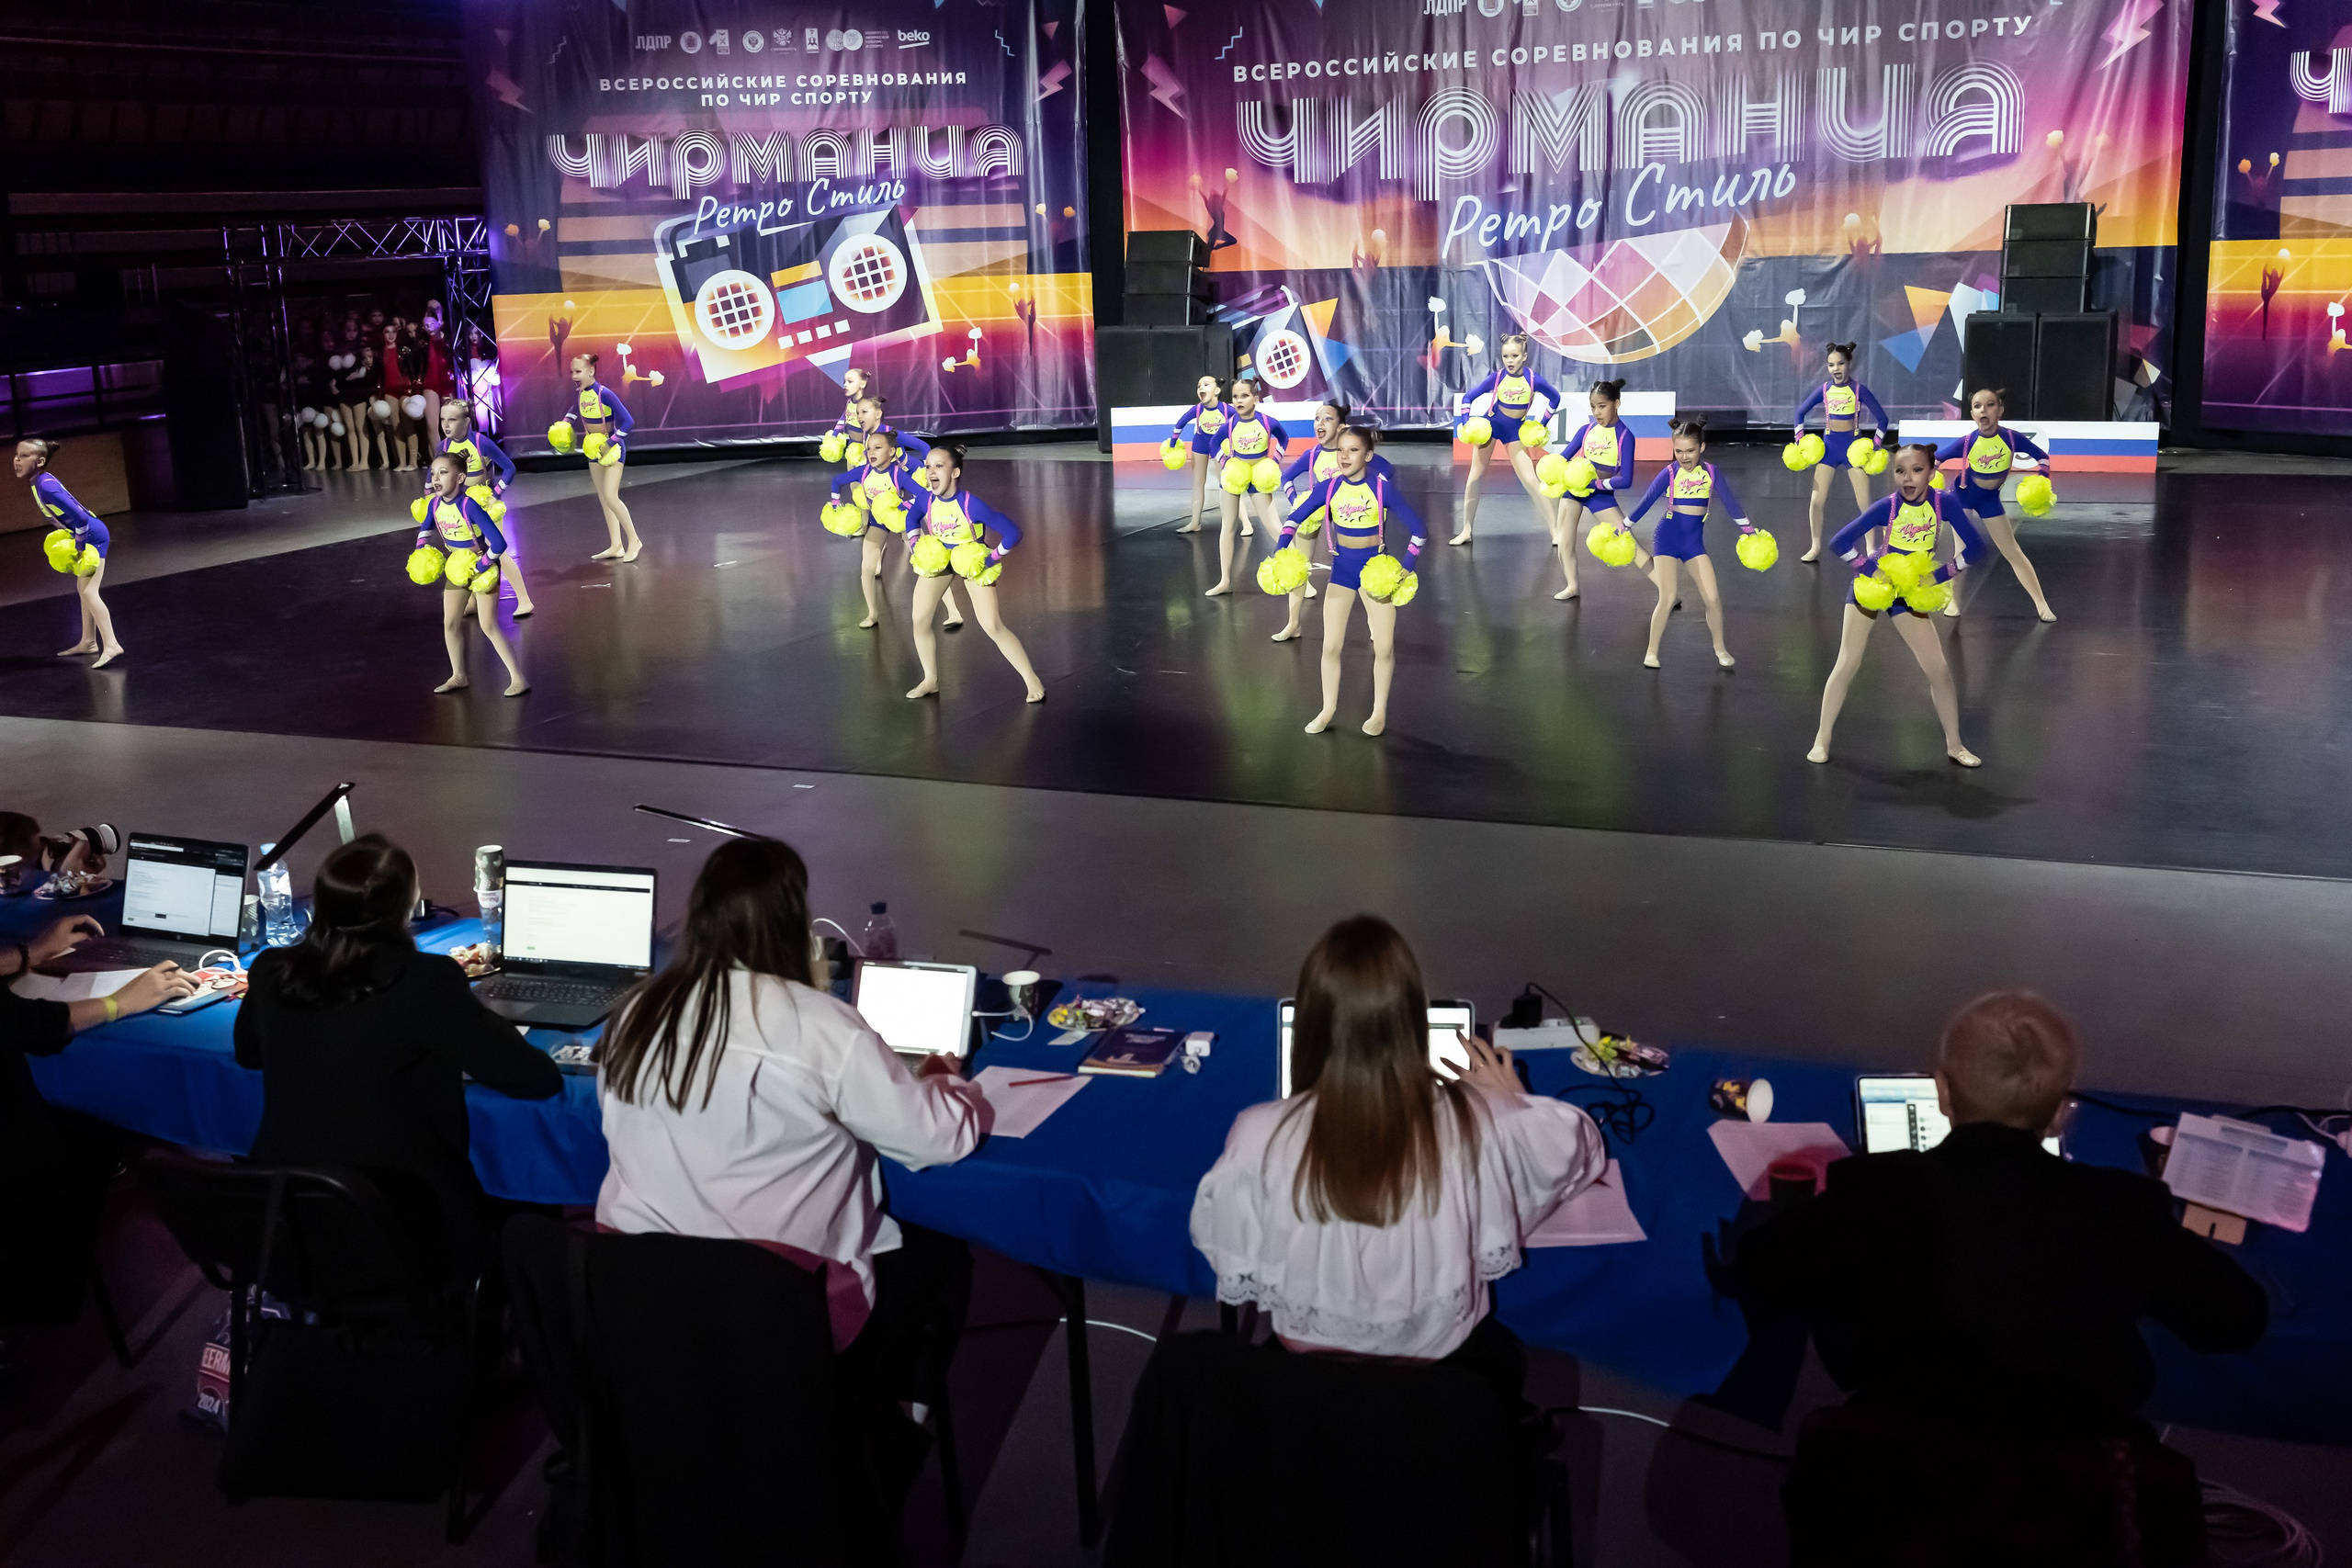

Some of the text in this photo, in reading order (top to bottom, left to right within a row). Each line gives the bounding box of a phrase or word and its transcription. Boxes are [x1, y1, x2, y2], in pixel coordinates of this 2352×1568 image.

[1423, 0, 1467, 17] ЛДПР
[635, 35, 672, 51] ЛДПР
[897, 29, 931, 41] beko
[1233, 16, 2032, 83] ВСЕРОССИЙСКИЕ СОРЕВНОВАНИЯ ПО ЧИР СПОРТУ
[599, 72, 967, 92] ВСЕРОССИЙСКИЕ СОРЕВНОВАНИЯ
[701, 91, 873, 107] ПО ЧИР СПОРТУ
[694, 177, 906, 235] Ретро Стиль
[1442, 162, 1797, 259] Ретро Стиль
[1552, 407, 1572, 445] 1
